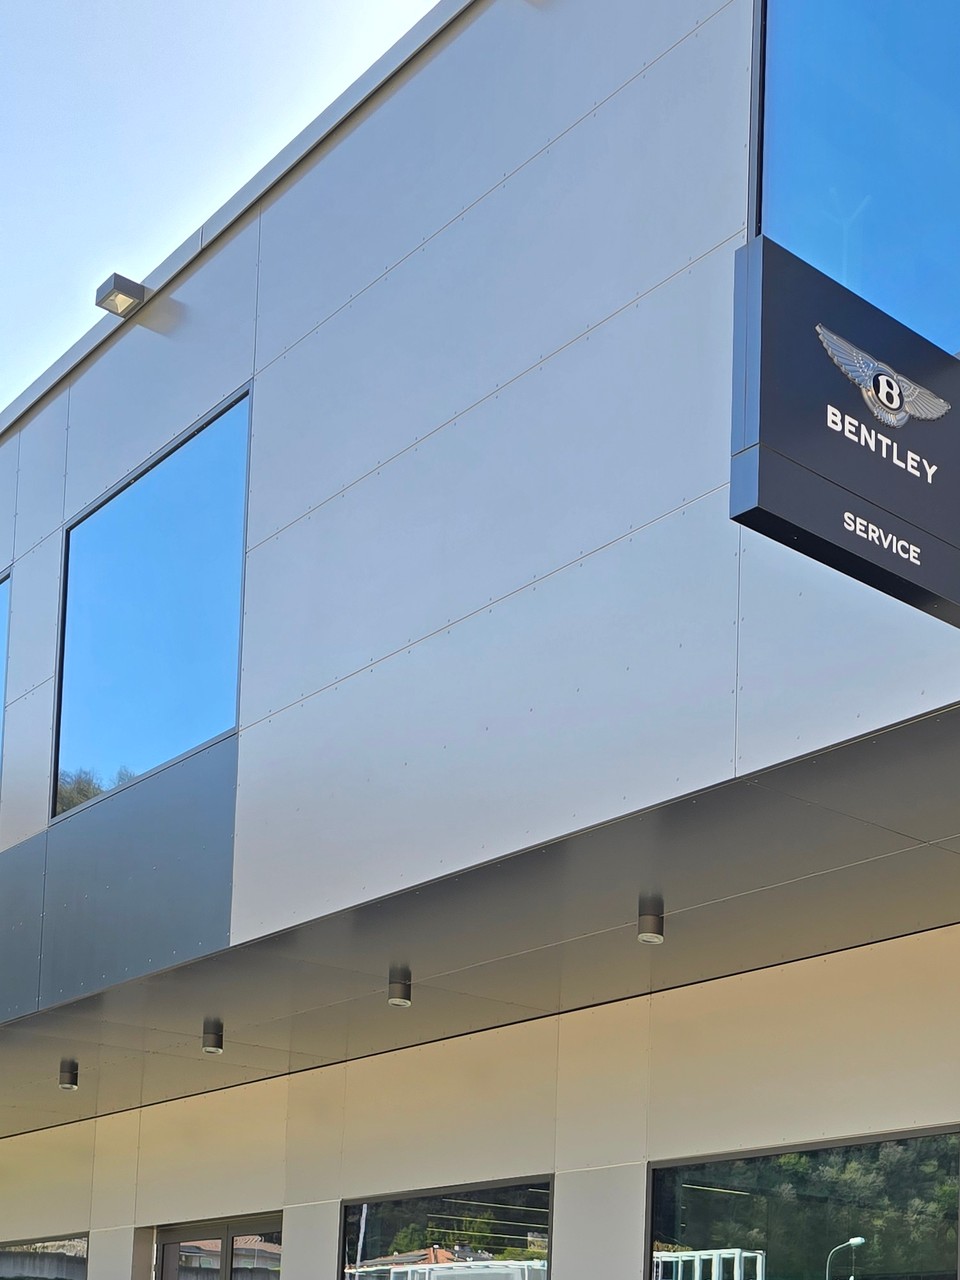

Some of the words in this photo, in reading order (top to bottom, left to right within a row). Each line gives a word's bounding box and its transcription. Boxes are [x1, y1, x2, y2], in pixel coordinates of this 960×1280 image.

[878, 375, 900, 409] B
[826, 404, 938, 484] BENTLEY
[843, 512, 921, 566] SERVICE
